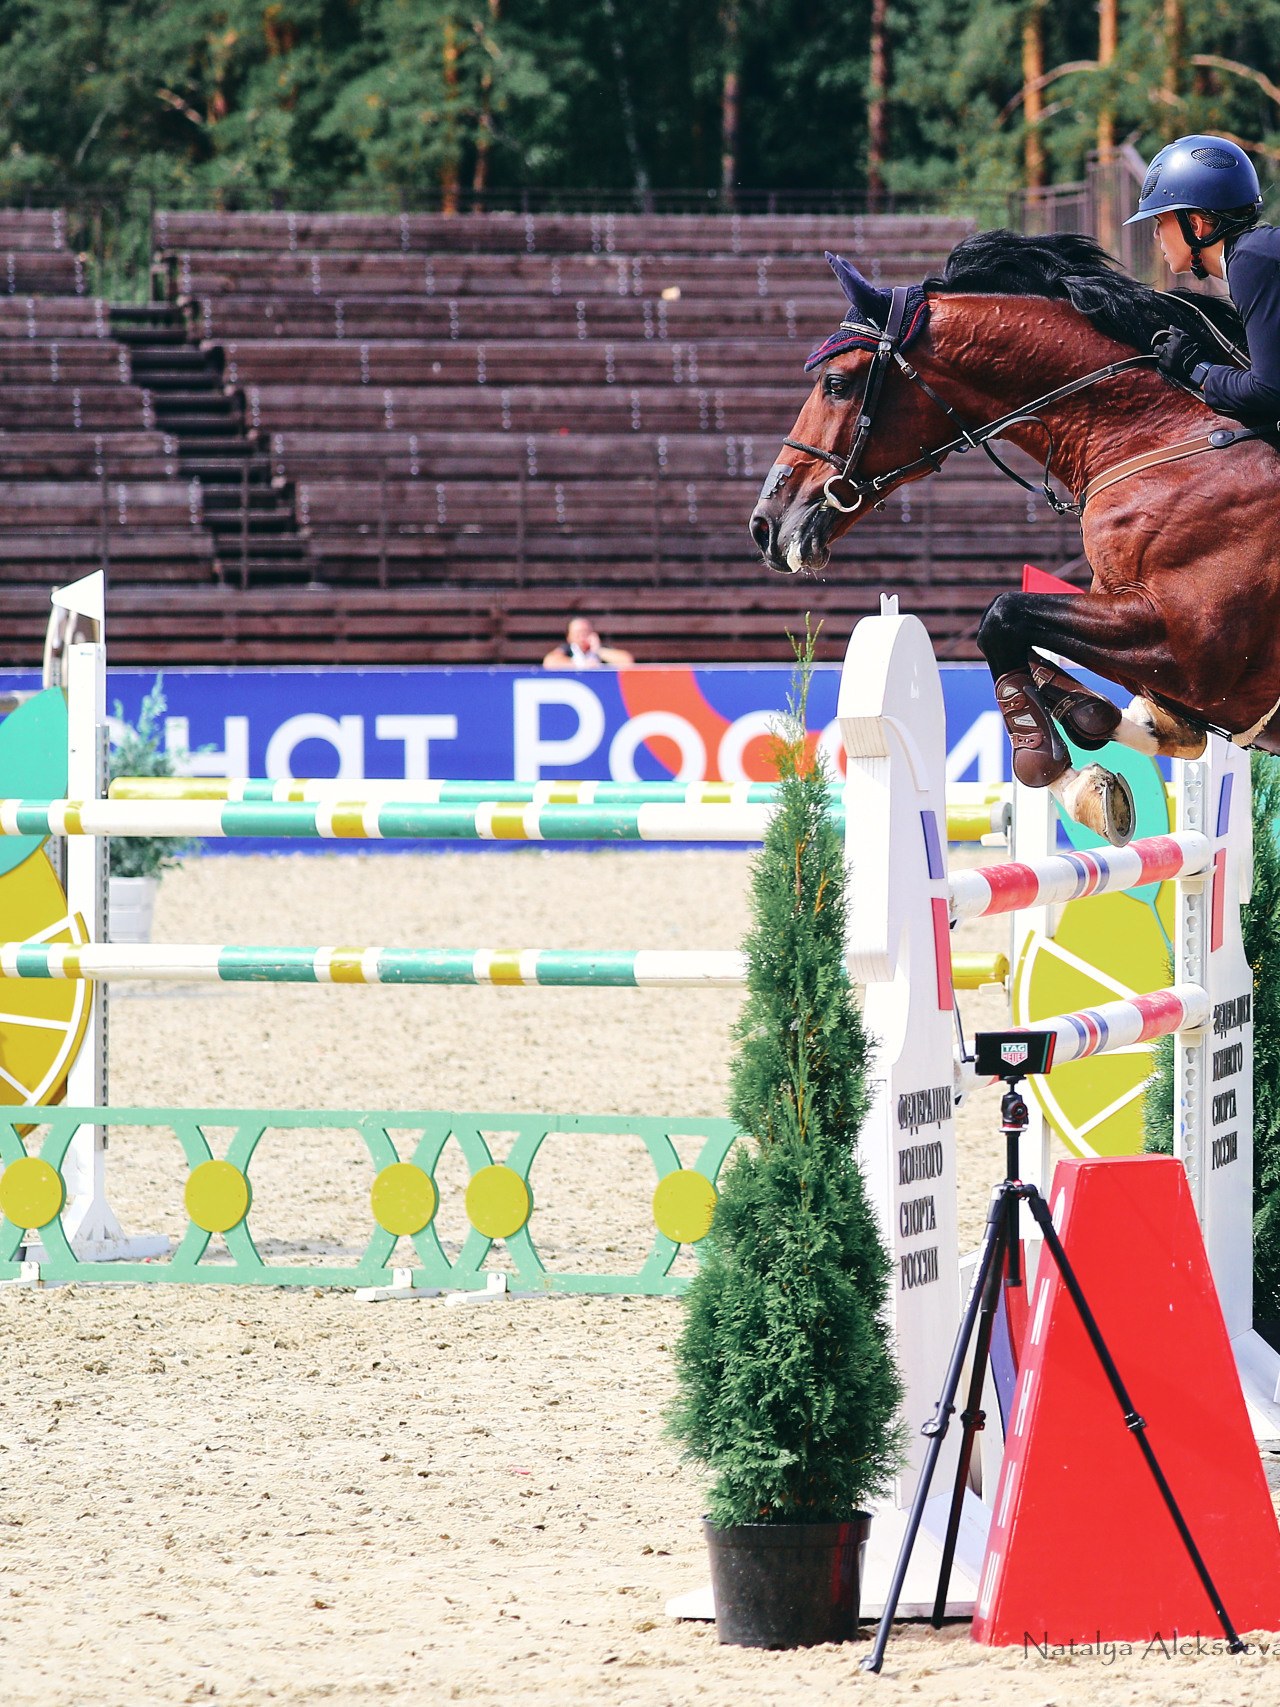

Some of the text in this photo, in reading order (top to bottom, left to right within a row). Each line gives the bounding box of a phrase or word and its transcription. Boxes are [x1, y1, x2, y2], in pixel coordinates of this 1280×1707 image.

[898, 1085, 953, 1136] ФЕДЕРАЦИЯ
[898, 1140, 944, 1186] КОННОГО
[899, 1195, 938, 1239] СПОРТА
[900, 1246, 940, 1291] РОССИИ
